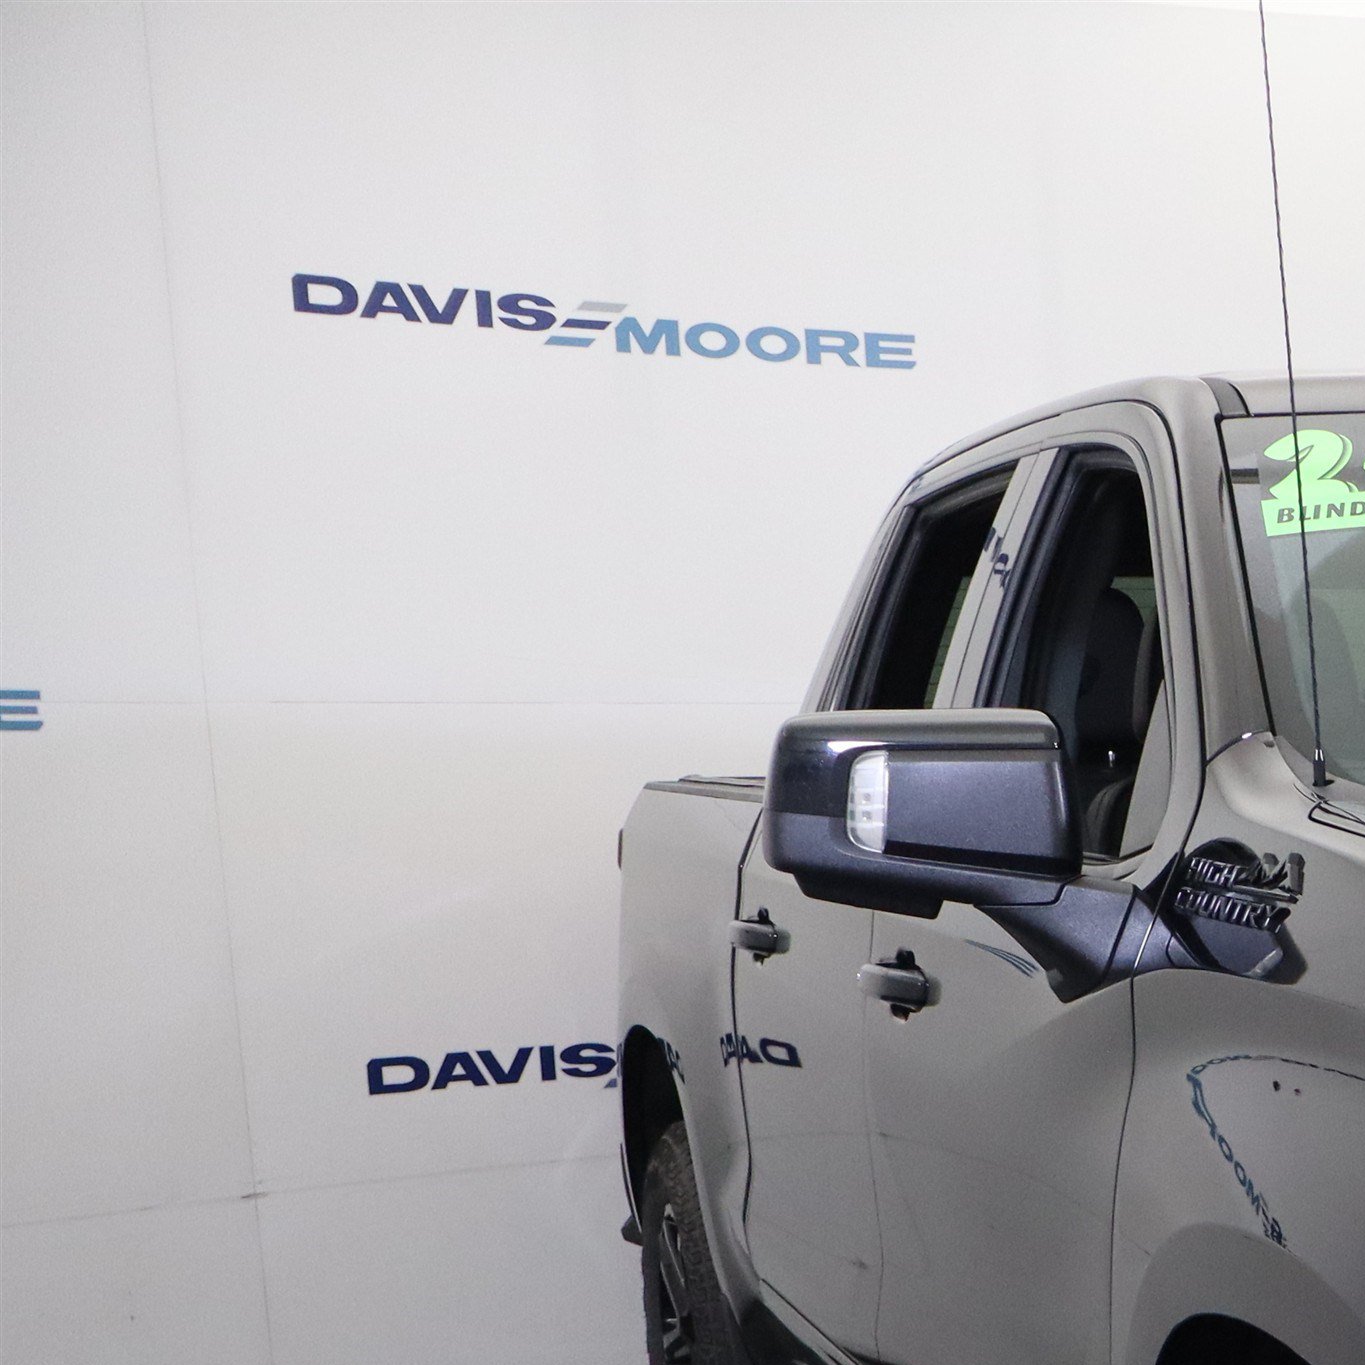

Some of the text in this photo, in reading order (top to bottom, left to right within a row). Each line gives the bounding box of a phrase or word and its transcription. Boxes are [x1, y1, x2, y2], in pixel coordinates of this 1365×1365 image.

[292, 272, 917, 370] DAVIS MOORE
[367, 1042, 617, 1095] DAVIS
